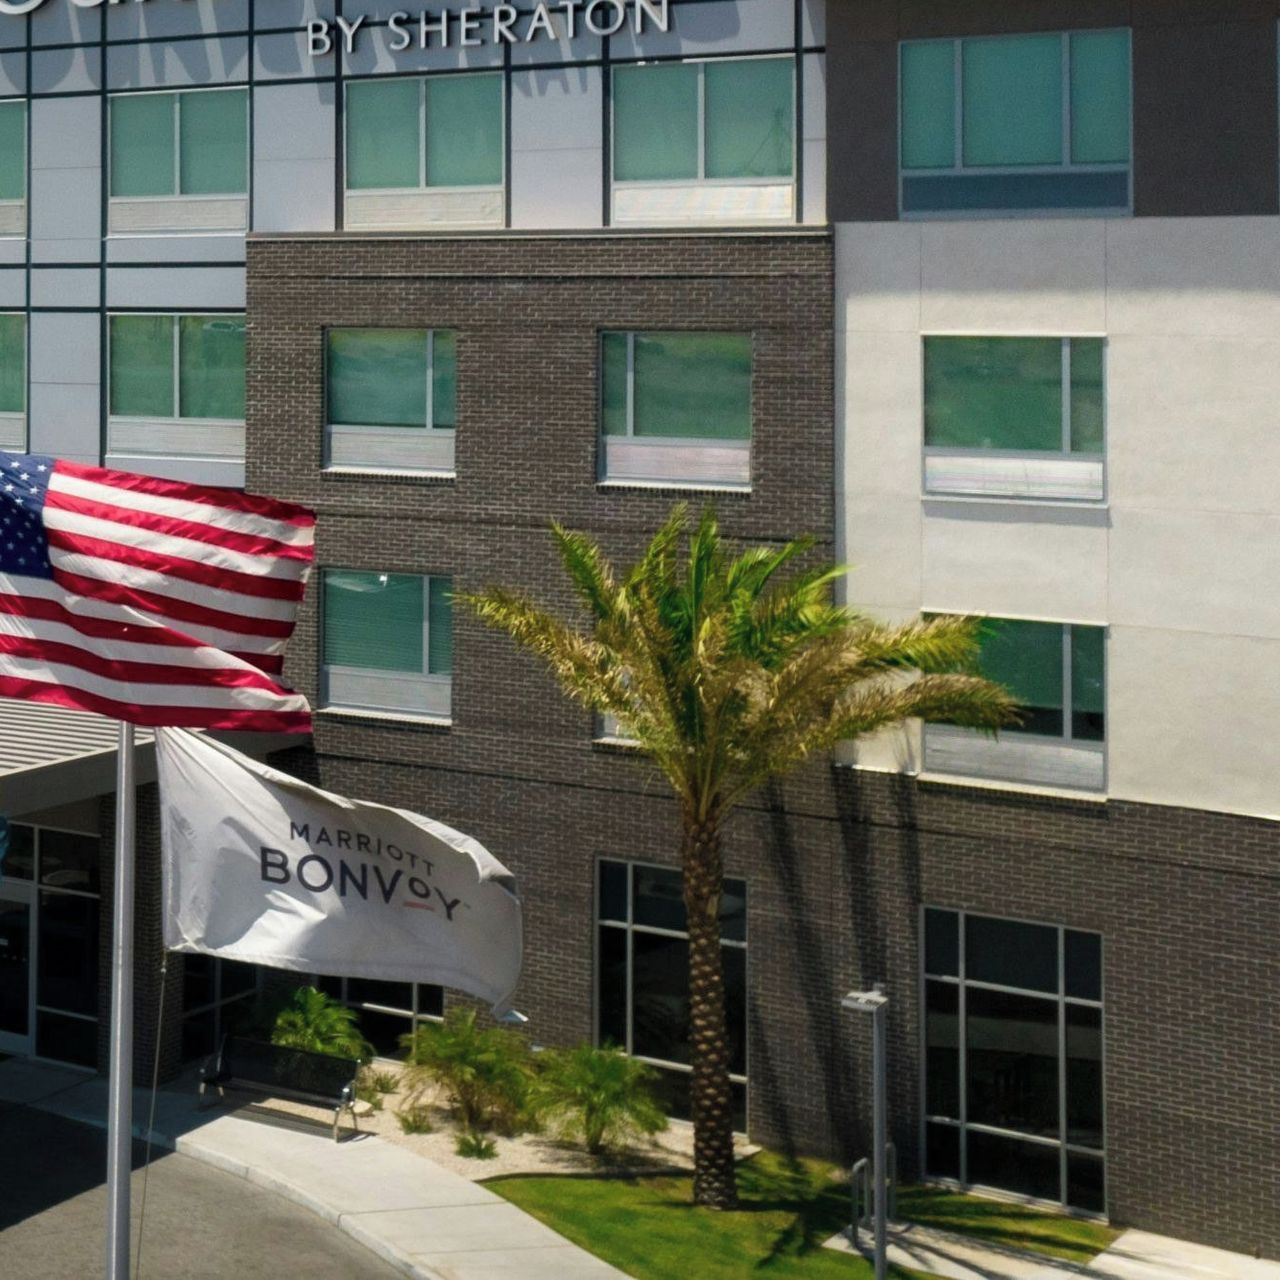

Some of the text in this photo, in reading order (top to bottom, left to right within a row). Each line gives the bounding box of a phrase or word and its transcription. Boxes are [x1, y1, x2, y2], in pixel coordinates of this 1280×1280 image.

[307, 15, 366, 56] BY
[290, 821, 435, 877] MARRIOTT
[259, 845, 462, 922] BONVOY
